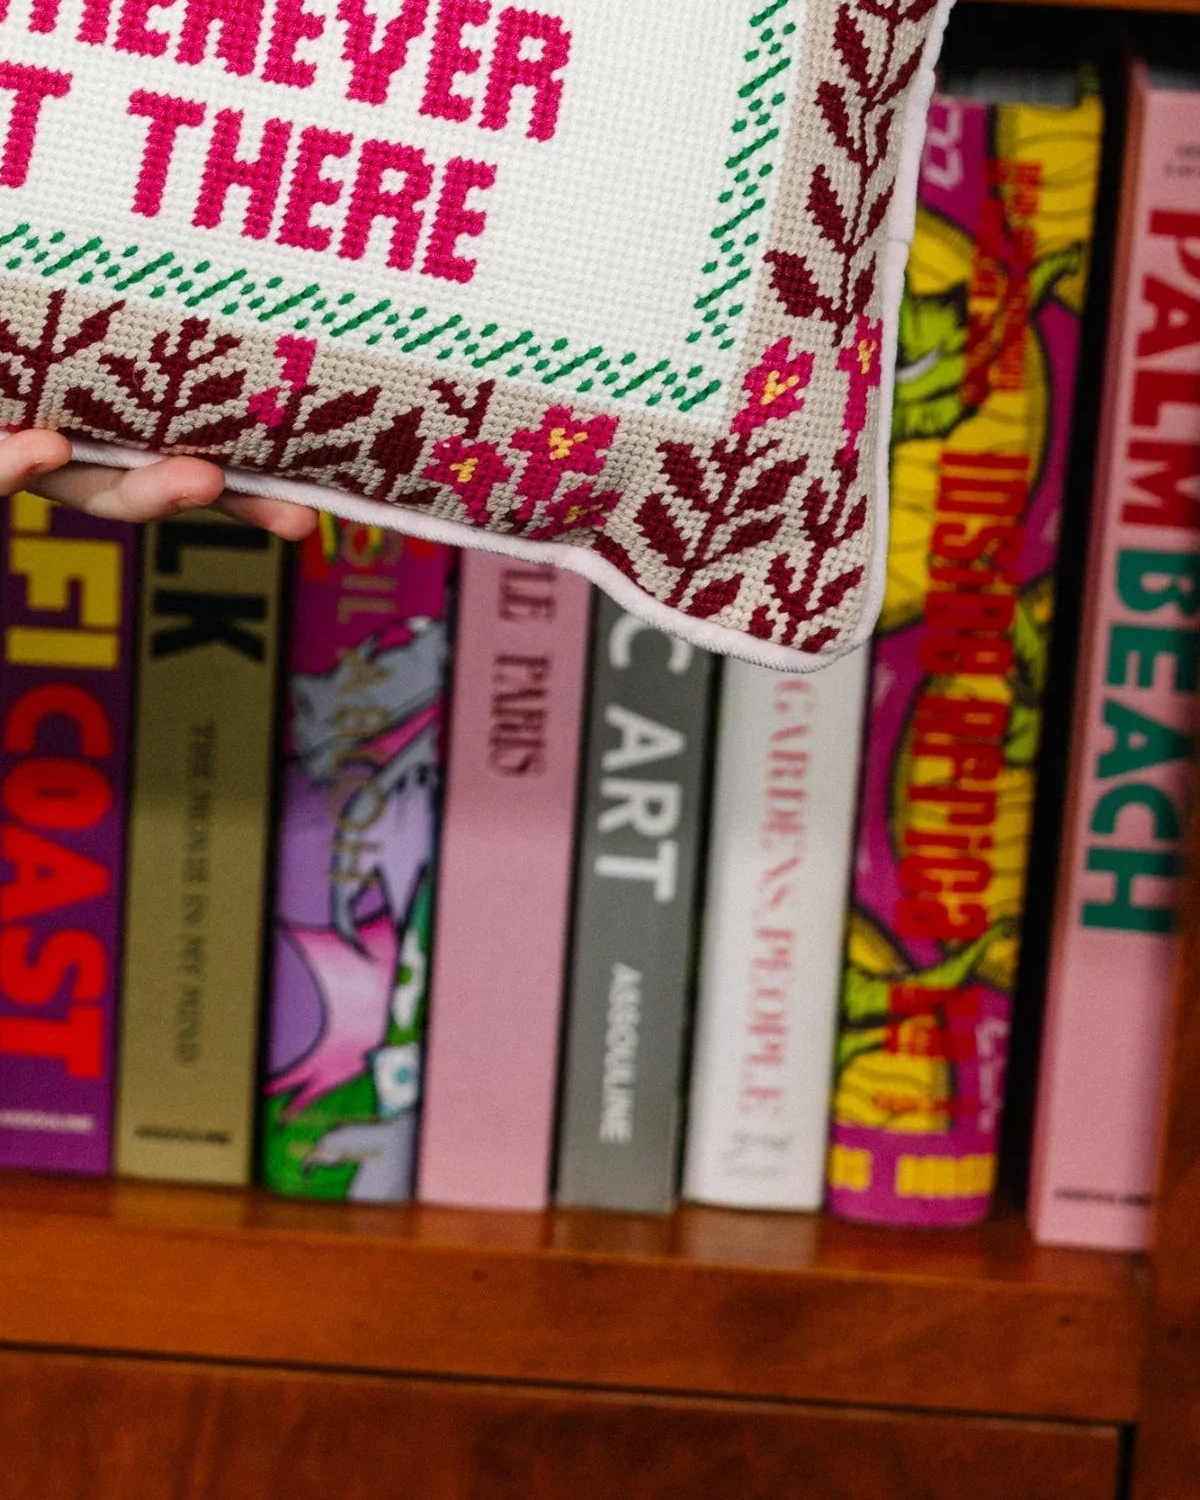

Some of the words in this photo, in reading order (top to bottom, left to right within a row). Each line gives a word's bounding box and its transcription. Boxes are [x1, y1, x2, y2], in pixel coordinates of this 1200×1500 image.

[126, 88, 498, 284] THERE
[1118, 208, 1200, 533] PALM
[487, 653, 552, 778] PARIS
[594, 704, 686, 902] ART
[1082, 548, 1200, 937] BEACH
[600, 962, 643, 1144] ASSOULINE
